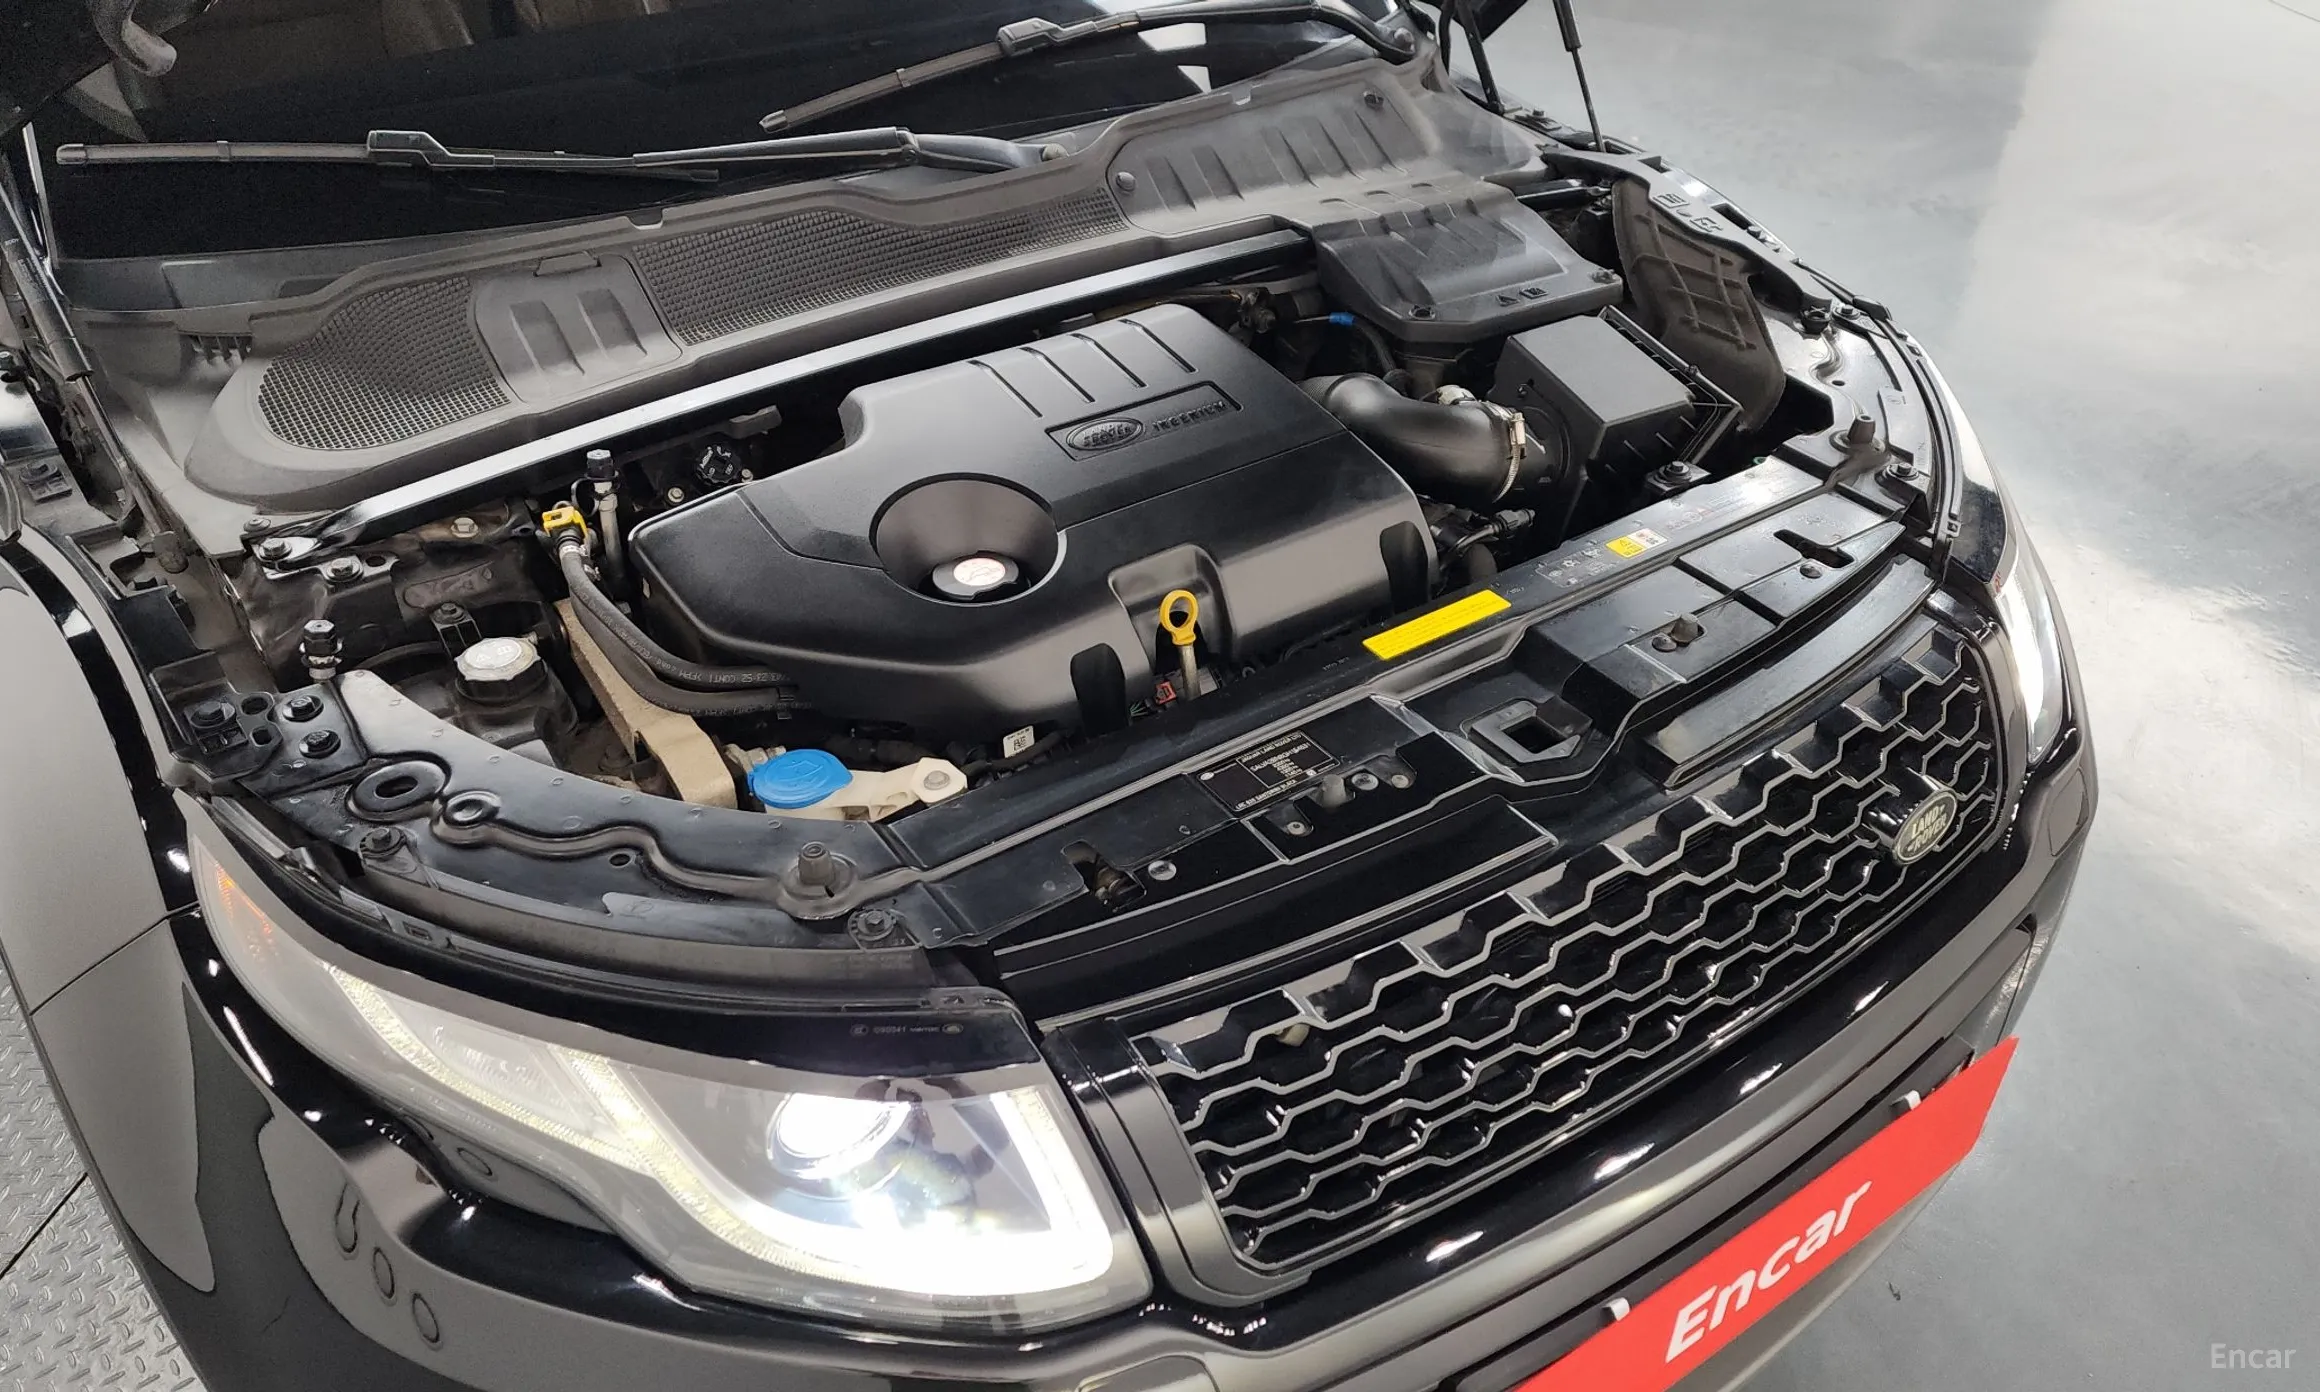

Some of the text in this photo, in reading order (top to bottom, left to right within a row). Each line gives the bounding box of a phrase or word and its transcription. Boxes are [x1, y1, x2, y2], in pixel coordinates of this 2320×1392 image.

[1911, 805, 1940, 840] LAND
[1913, 812, 1947, 853] ROVER
[1665, 1181, 1873, 1364] Encar
